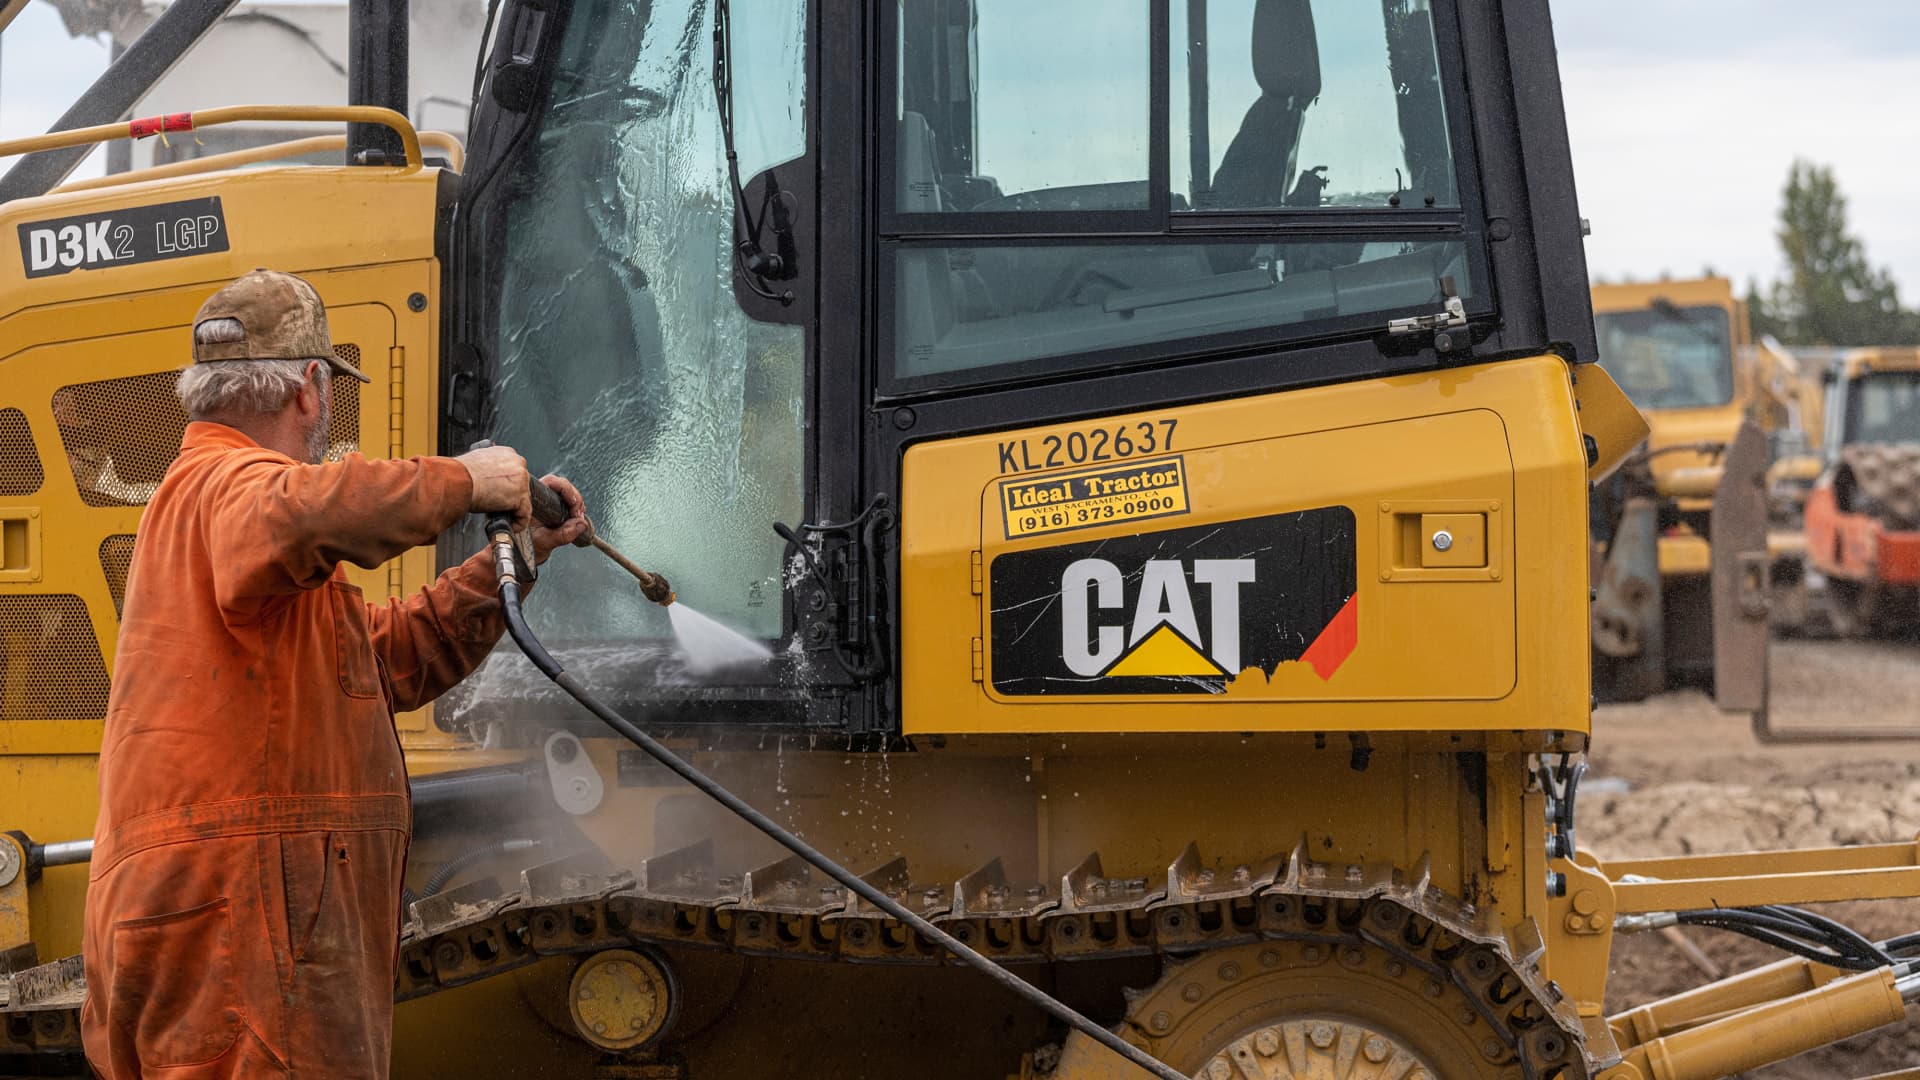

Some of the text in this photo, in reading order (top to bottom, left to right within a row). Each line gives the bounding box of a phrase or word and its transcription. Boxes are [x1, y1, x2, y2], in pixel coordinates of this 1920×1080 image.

[30, 215, 219, 271] D3K2 LGP
[998, 419, 1178, 474] KL202637
[1012, 469, 1177, 508] Ideal Tractor
[1032, 504, 1060, 514] WEST
[1144, 490, 1160, 498] CA
[1019, 496, 1174, 532] (916) 373-0900
[1061, 558, 1256, 676] CAT
